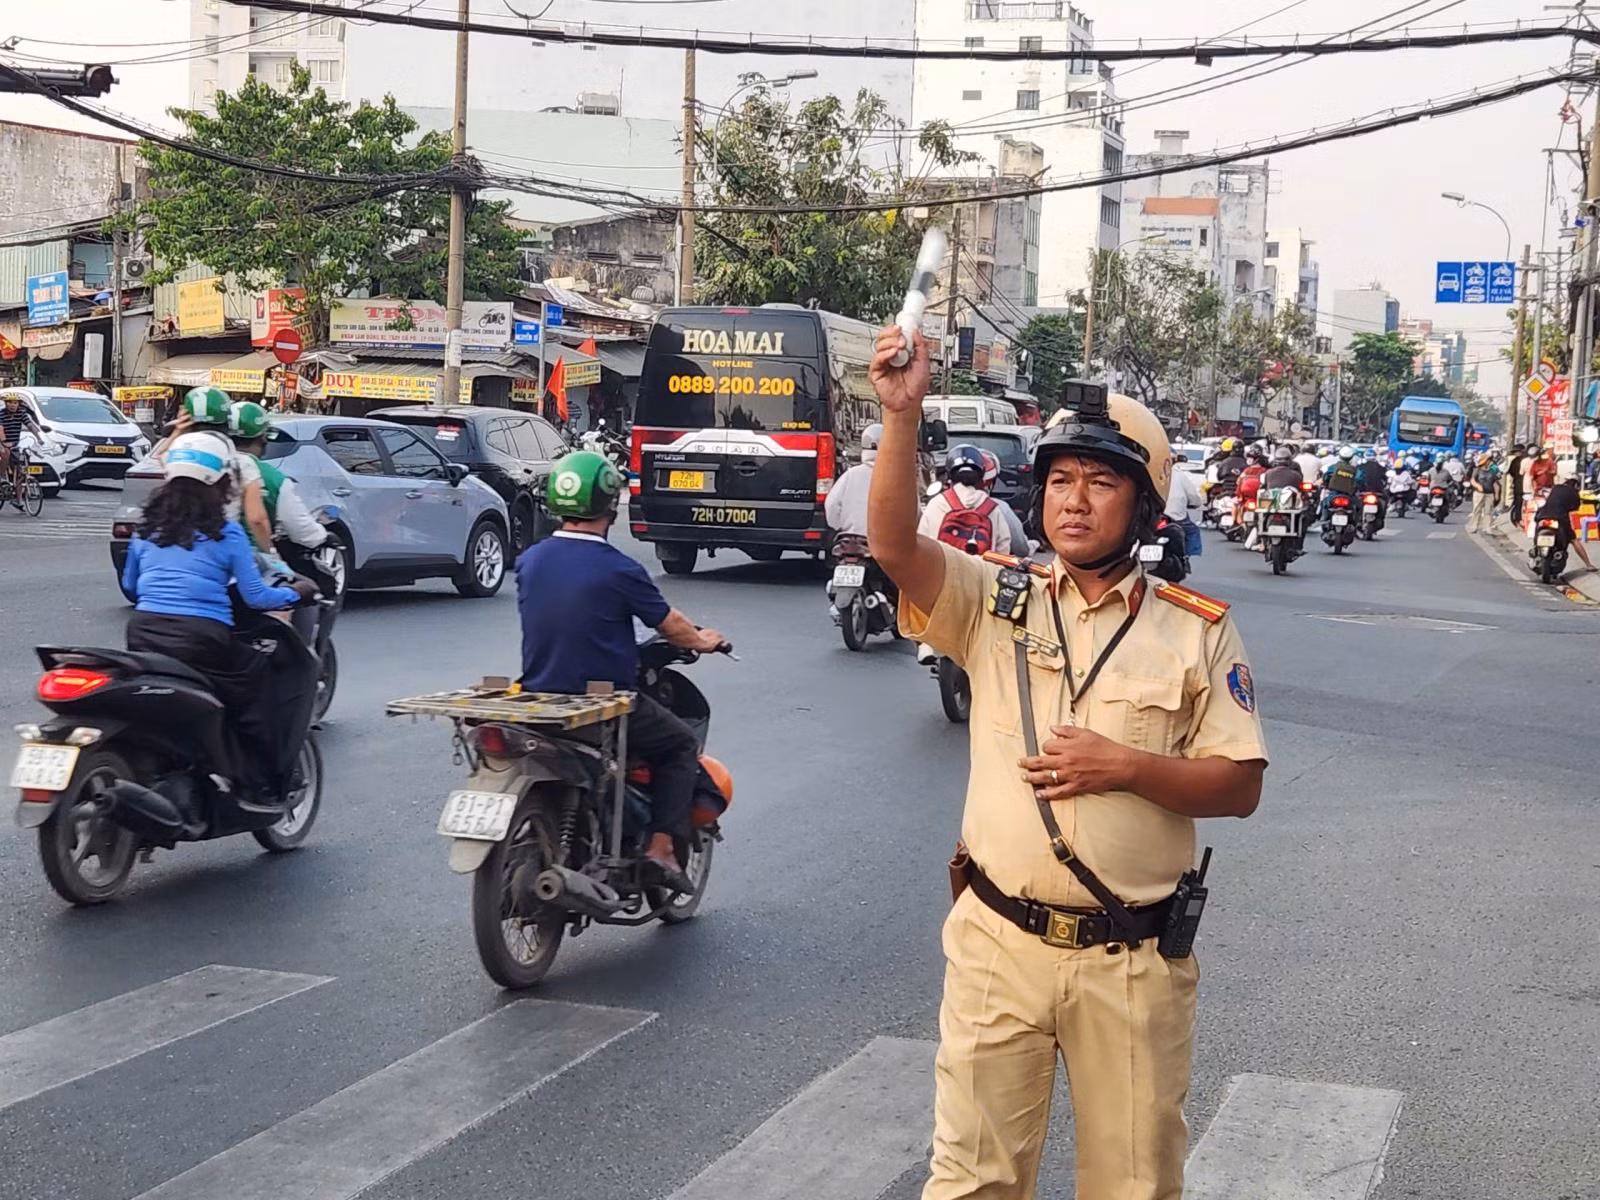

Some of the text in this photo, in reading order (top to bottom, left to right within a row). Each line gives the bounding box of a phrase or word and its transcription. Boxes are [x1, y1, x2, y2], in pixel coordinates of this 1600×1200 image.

[712, 360, 753, 368] HOTLINE
[326, 374, 357, 387] DUY
[669, 375, 795, 395] 0889.200.200
[680, 471, 695, 480] 72H
